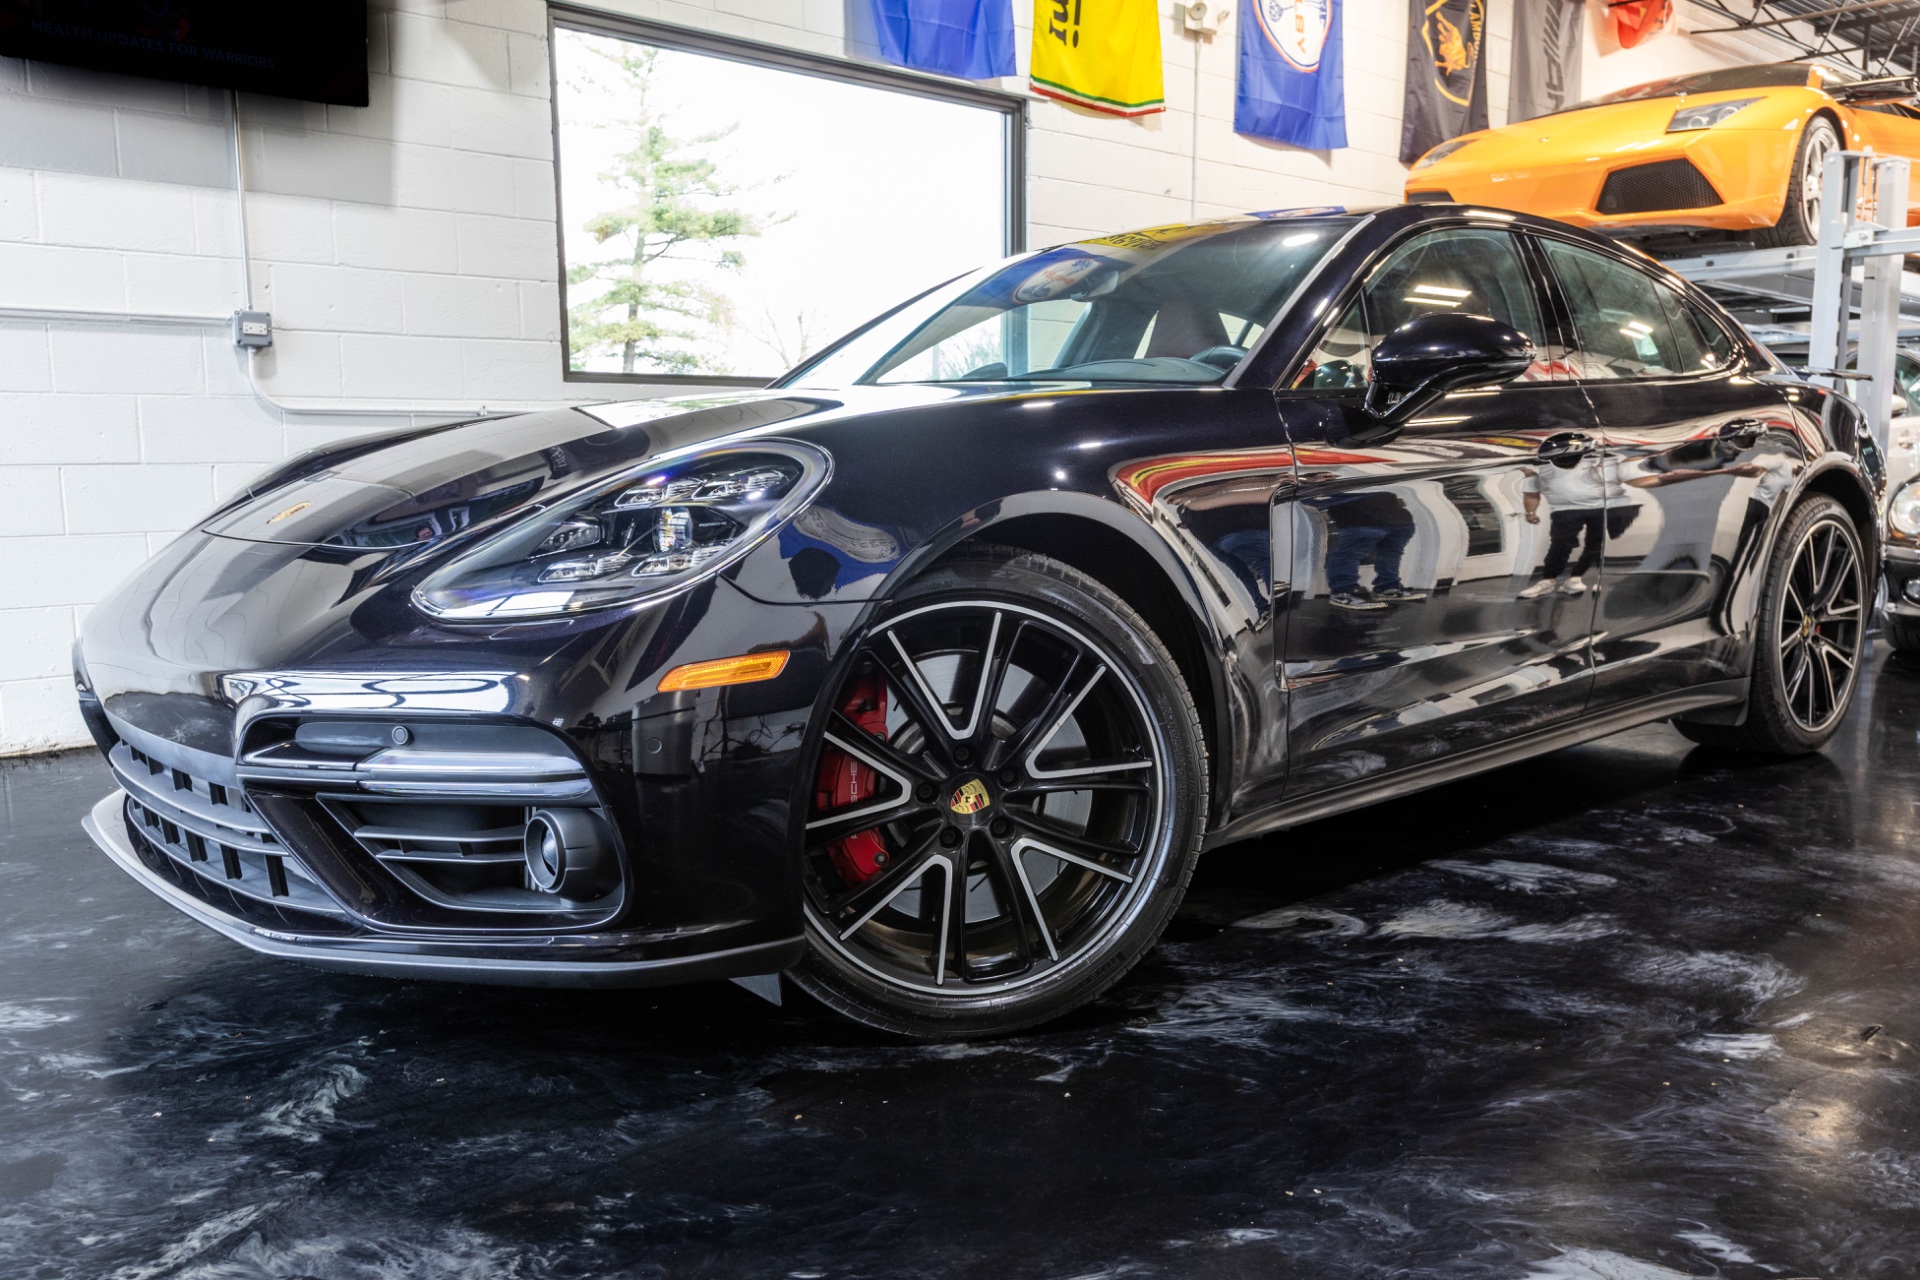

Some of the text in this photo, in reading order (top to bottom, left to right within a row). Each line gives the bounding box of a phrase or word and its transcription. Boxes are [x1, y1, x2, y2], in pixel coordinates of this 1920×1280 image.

[31, 19, 275, 69] HEALTH UPDATES FOR WARRIORS
